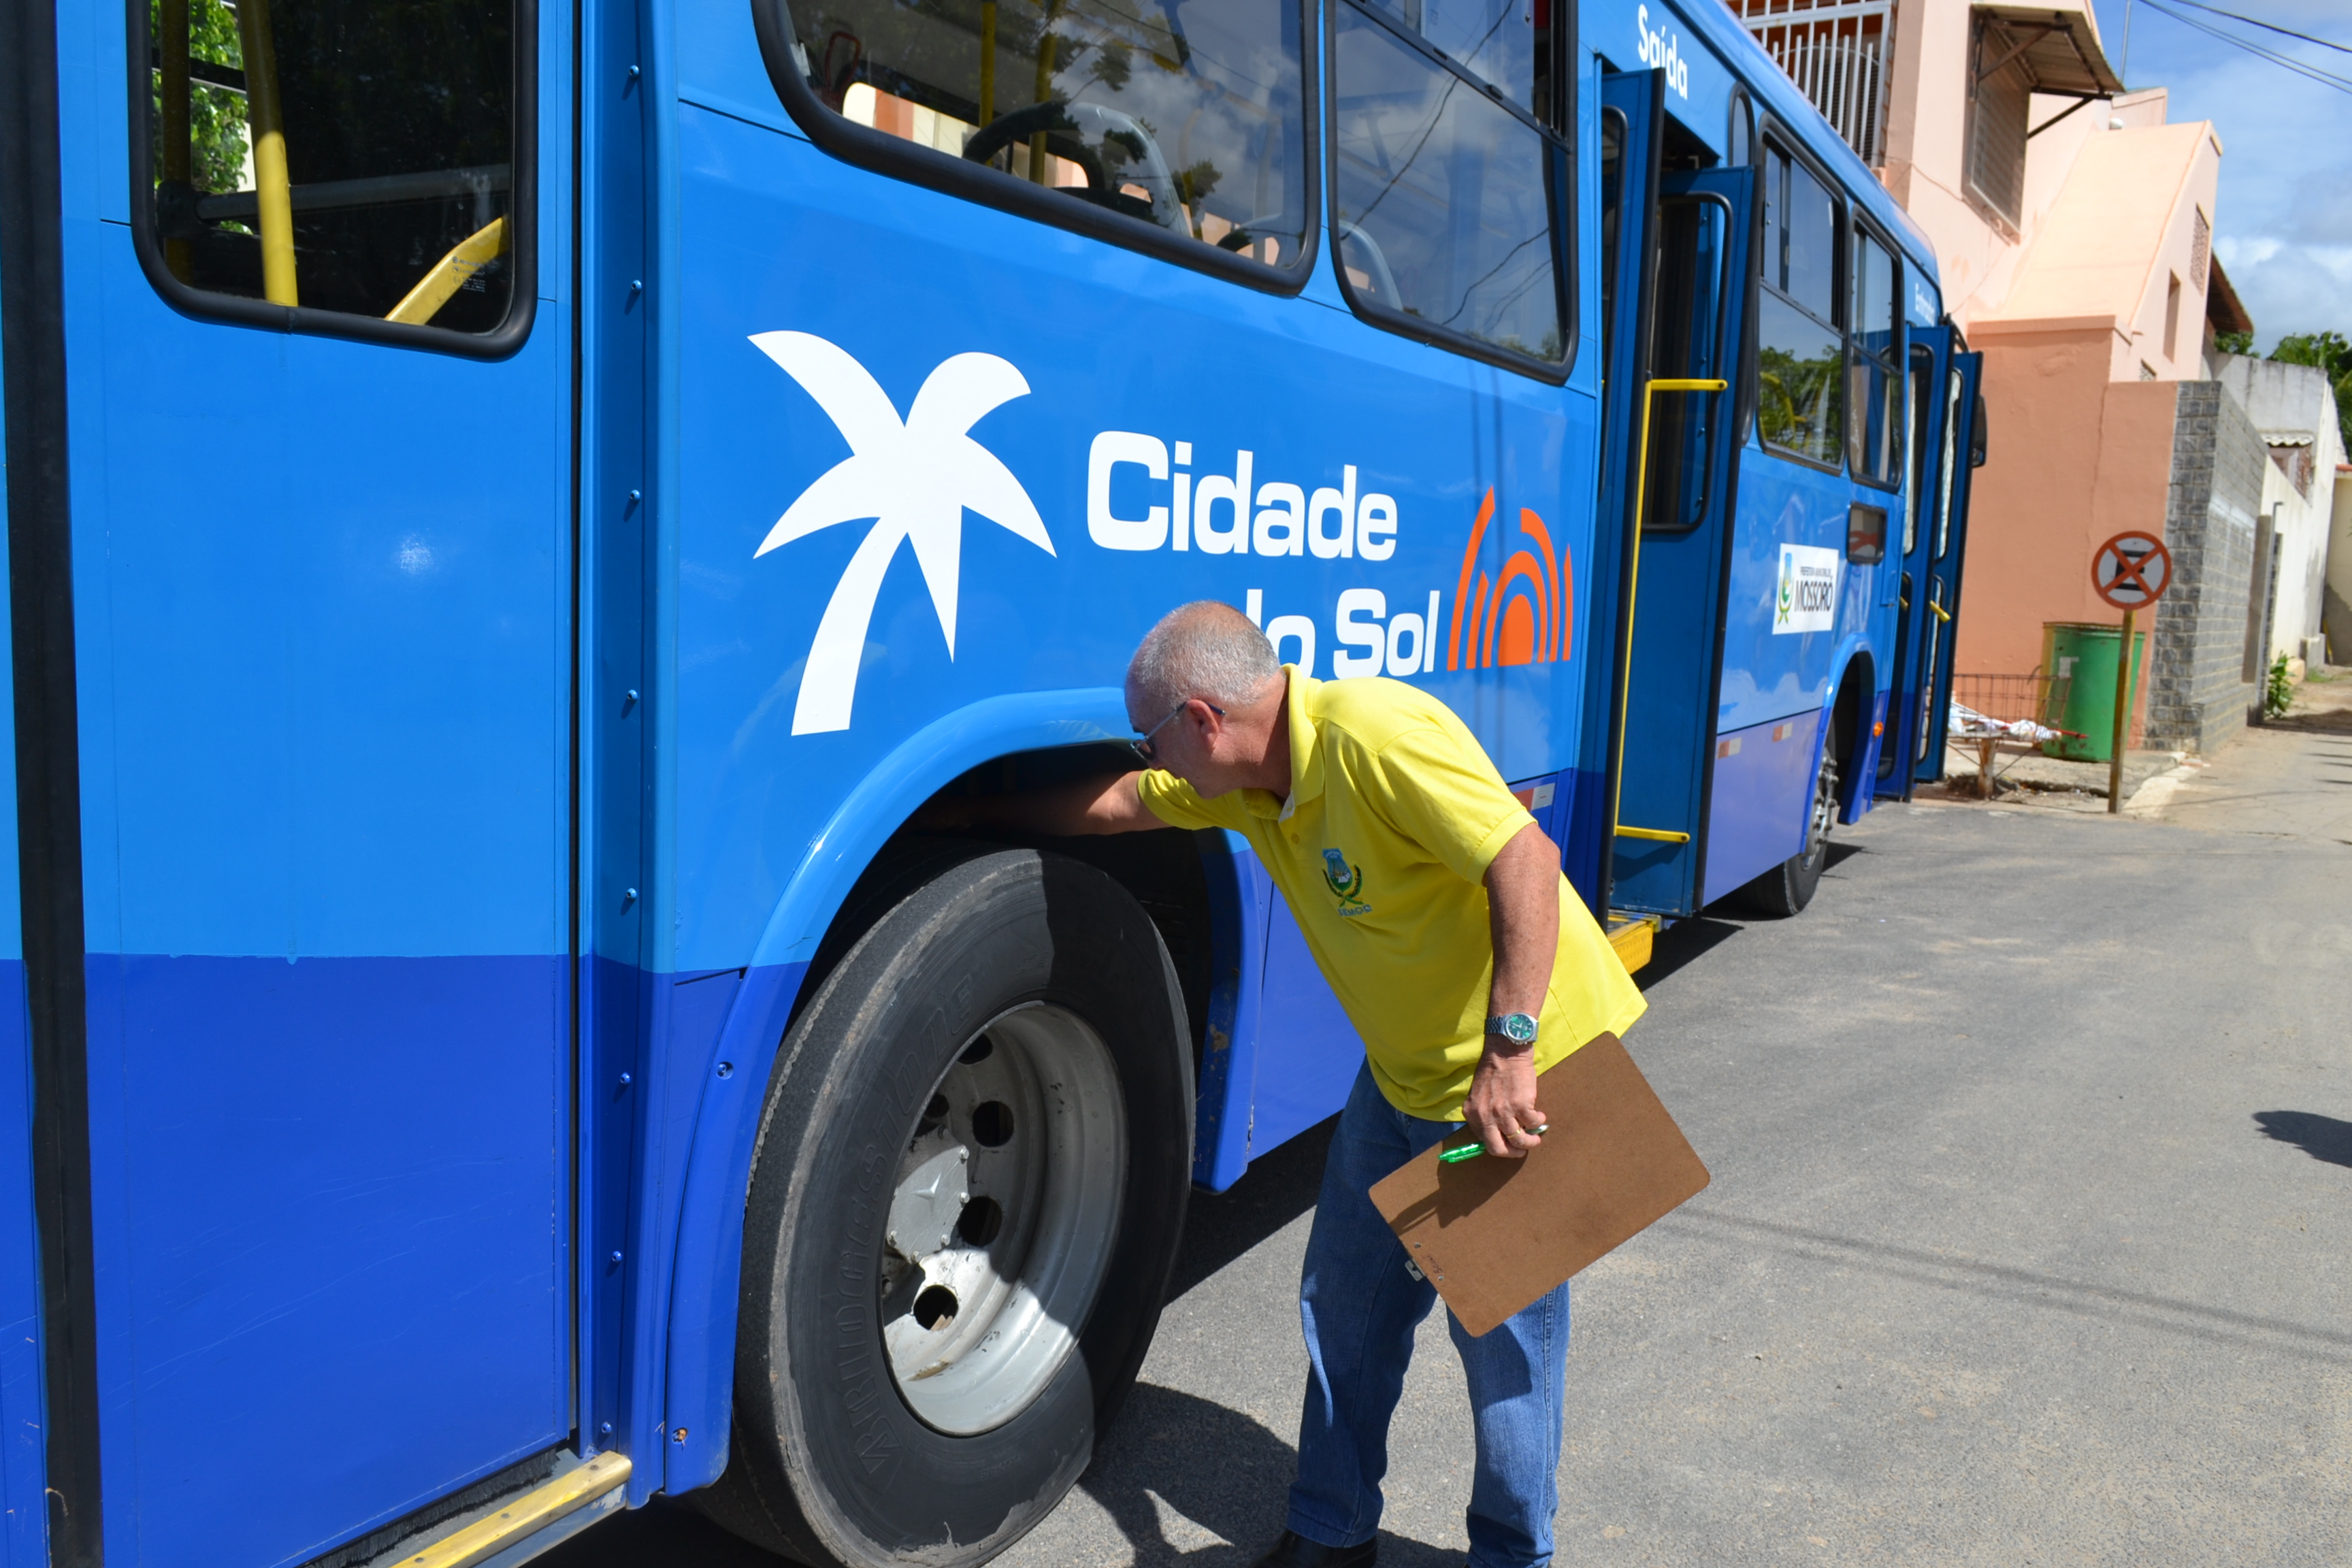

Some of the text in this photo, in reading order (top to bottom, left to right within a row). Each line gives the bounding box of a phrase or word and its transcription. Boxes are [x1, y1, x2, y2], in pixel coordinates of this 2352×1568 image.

[1638, 3, 1688, 101] Saída
[1087, 431, 1398, 561] Cidade
[1334, 588, 1440, 679] Sol
